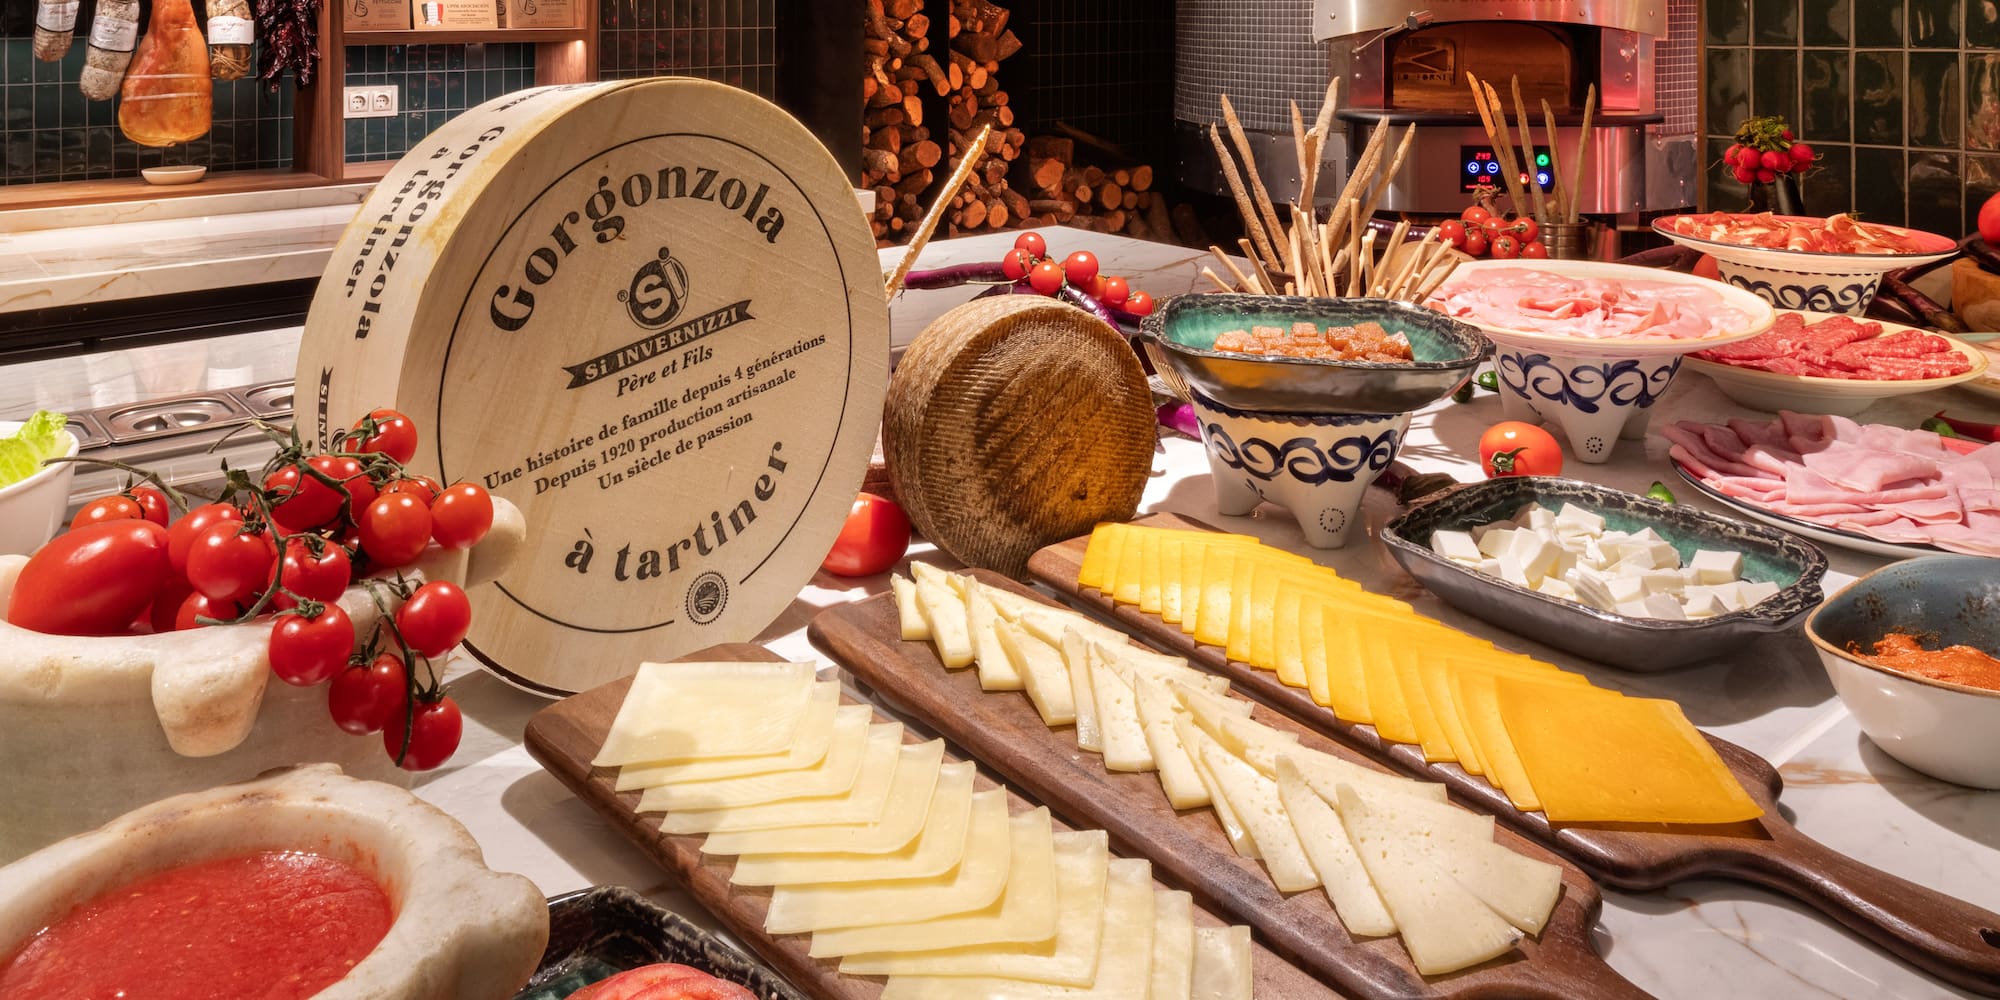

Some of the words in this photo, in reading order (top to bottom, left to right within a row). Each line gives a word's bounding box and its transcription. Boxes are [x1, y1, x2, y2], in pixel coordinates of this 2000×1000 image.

[345, 169, 429, 298] tartiner
[355, 126, 505, 340] Gorgonzola
[490, 166, 785, 332] Gorgonzola
[584, 359, 608, 380] Si
[615, 306, 738, 368] INVERNIZZI
[617, 374, 656, 398] Père
[661, 359, 678, 379] et
[682, 345, 713, 370] Fils
[483, 467, 522, 490] Une
[526, 436, 594, 473] histoire
[598, 424, 618, 441] de
[622, 397, 678, 431] famille
[682, 374, 731, 404] depuis
[734, 366, 743, 380] 4
[746, 334, 826, 379] générations
[534, 458, 597, 495] Depuis
[601, 438, 636, 465] 1920
[639, 402, 724, 452] production
[726, 369, 797, 407] artisanale
[597, 470, 624, 490] Un
[627, 449, 671, 478] siècle
[675, 439, 693, 455] de
[697, 412, 753, 449] passion
[565, 528, 594, 574] à
[614, 441, 788, 582] tartiner
